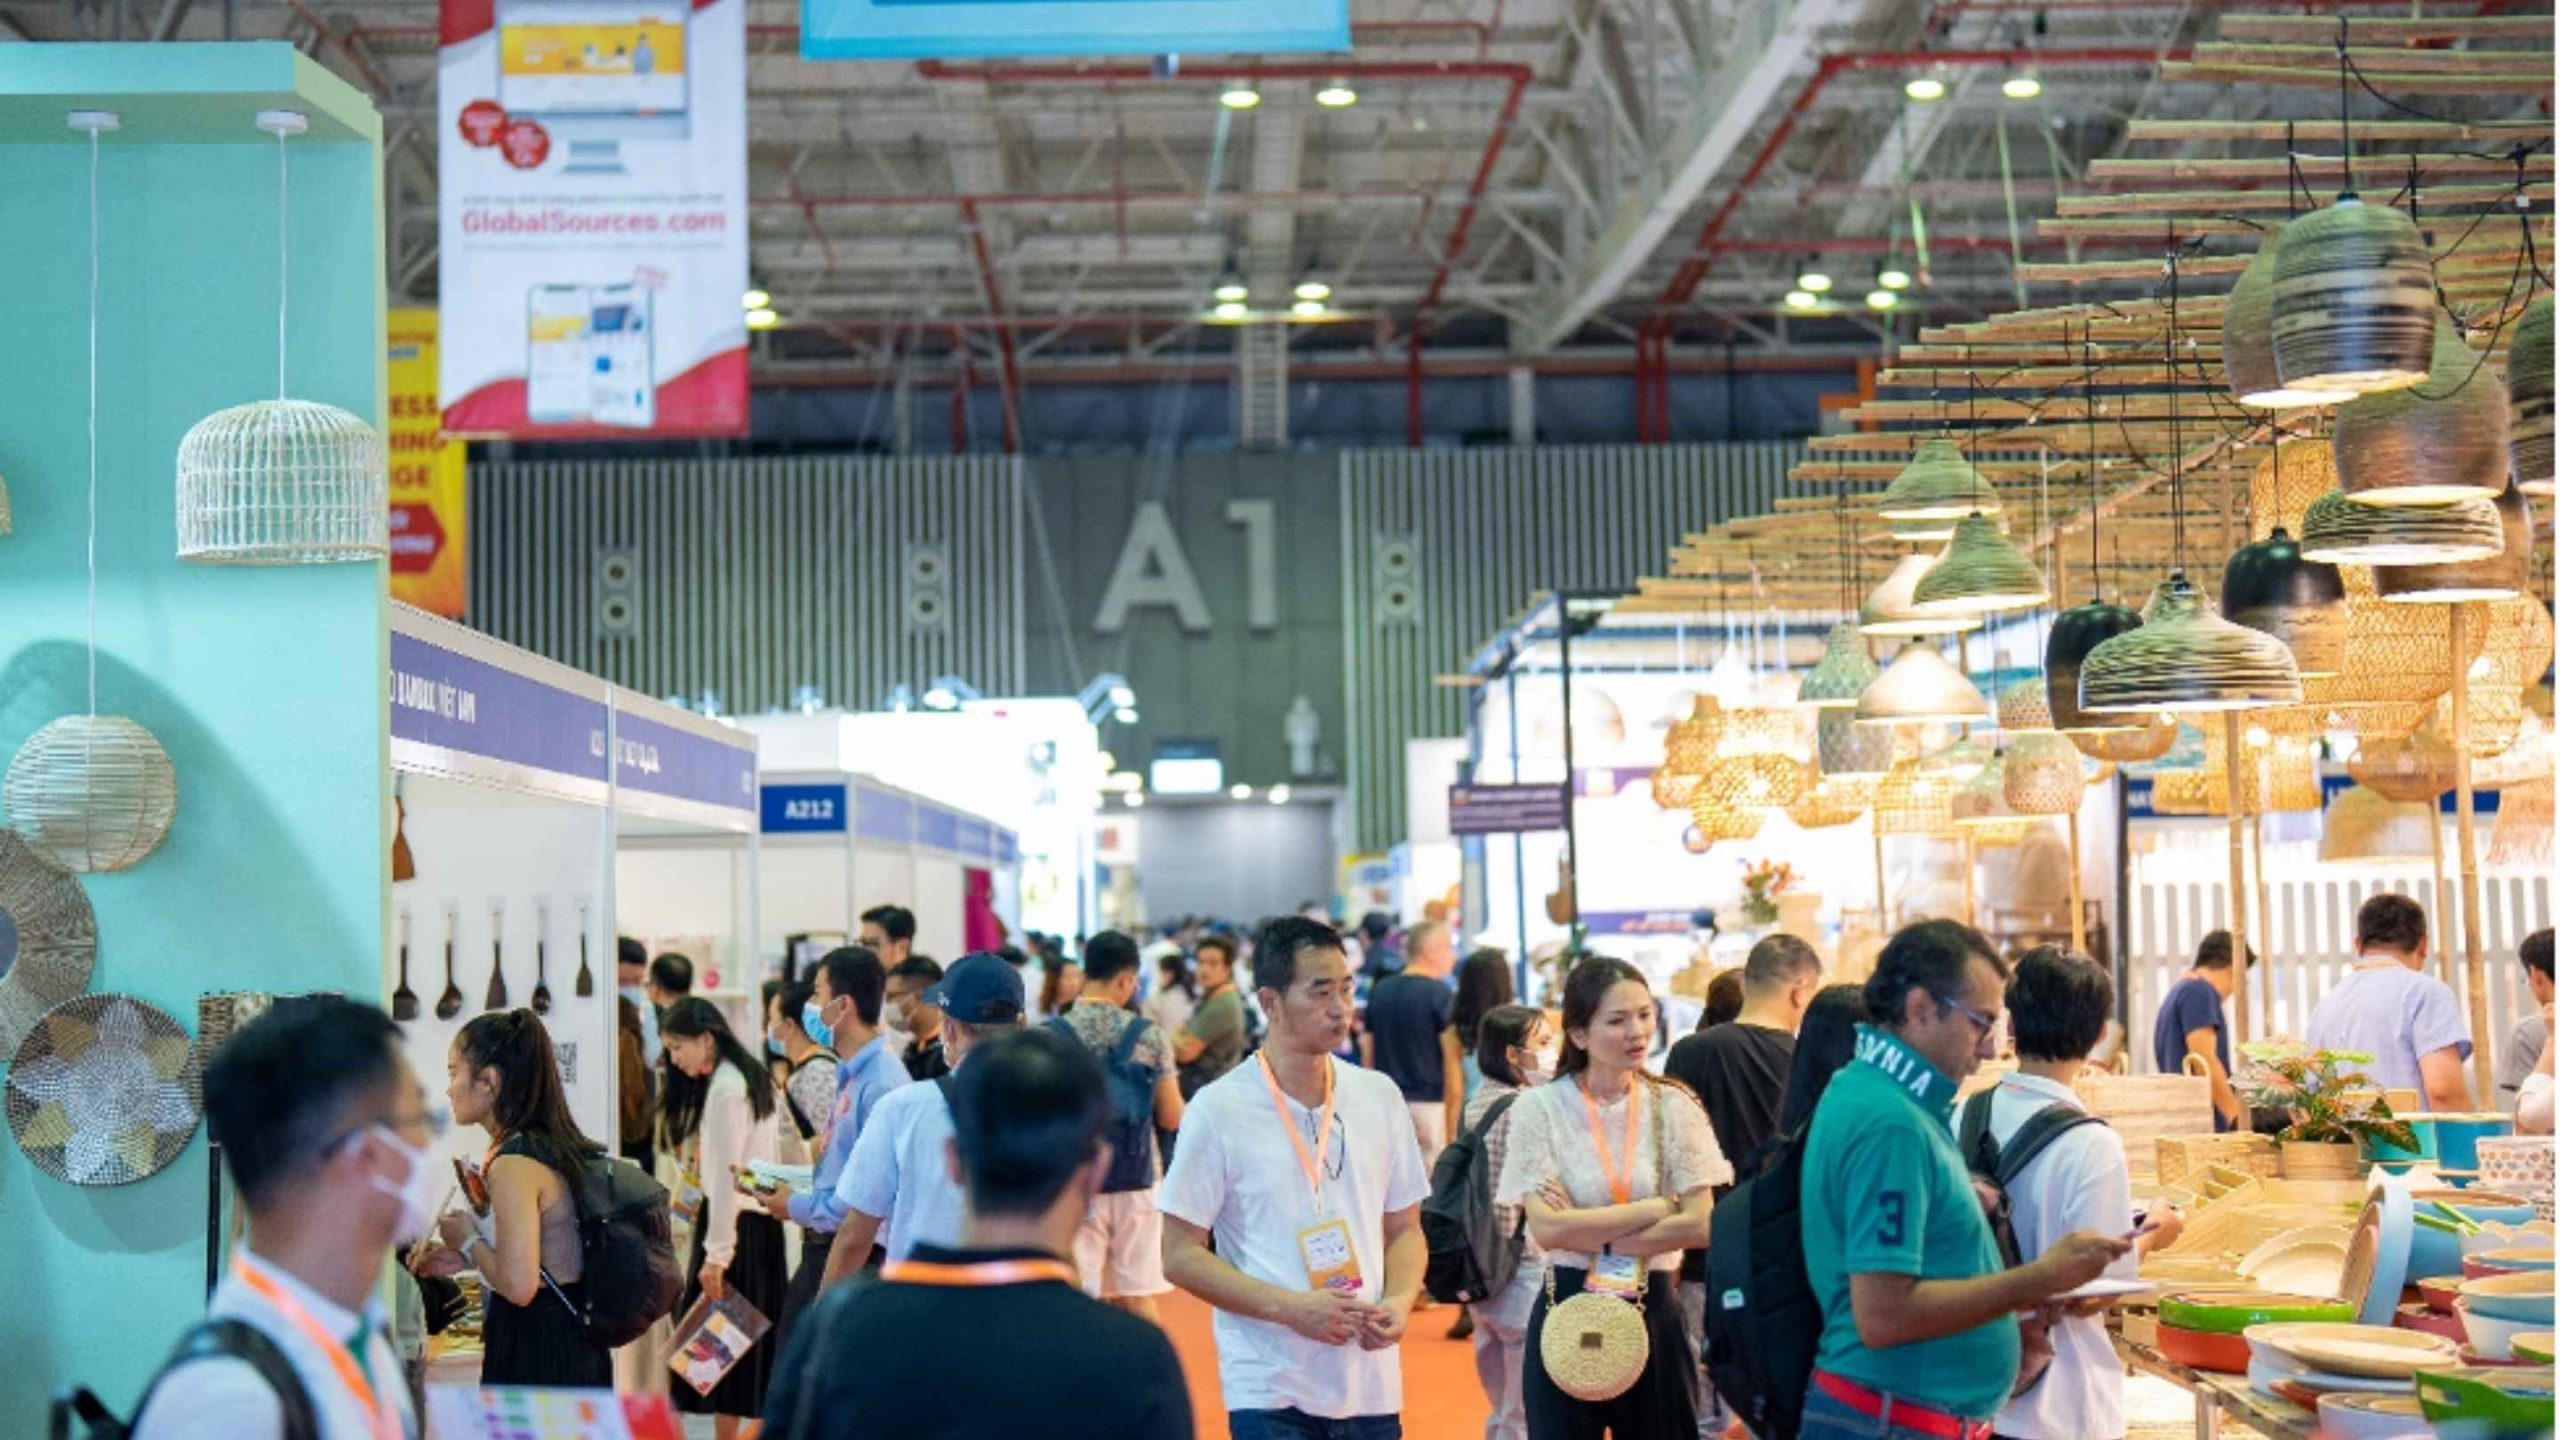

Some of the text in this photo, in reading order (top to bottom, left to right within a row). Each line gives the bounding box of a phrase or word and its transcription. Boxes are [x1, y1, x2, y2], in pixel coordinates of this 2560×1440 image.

[462, 208, 727, 235] GlobalSources.com
[1095, 499, 1275, 630] A1
[785, 799, 834, 820] A212
[1876, 1189, 1905, 1247] 3
